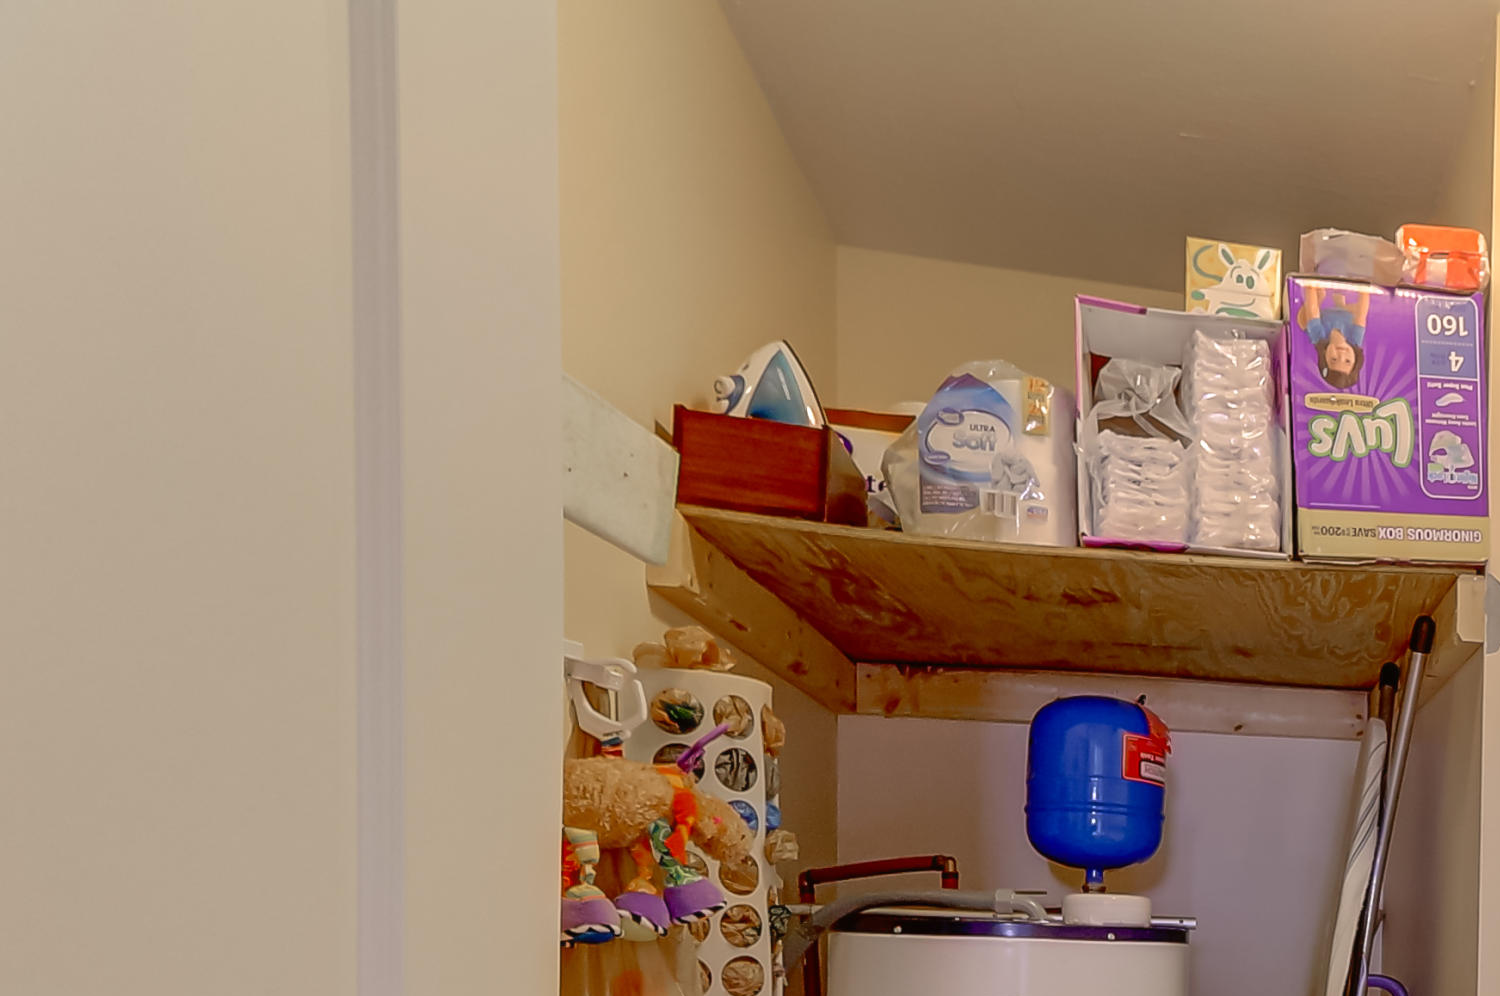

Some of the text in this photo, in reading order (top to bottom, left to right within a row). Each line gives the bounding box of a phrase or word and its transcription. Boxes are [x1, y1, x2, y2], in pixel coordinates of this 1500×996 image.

[1427, 314, 1469, 337] 160
[1448, 351, 1465, 373] 4
[970, 424, 996, 433] ULTRA
[1309, 399, 1413, 466] Luvs
[1352, 527, 1377, 538] SAVE
[1378, 526, 1404, 540] BOX
[1407, 527, 1482, 543] GINORMOUS
